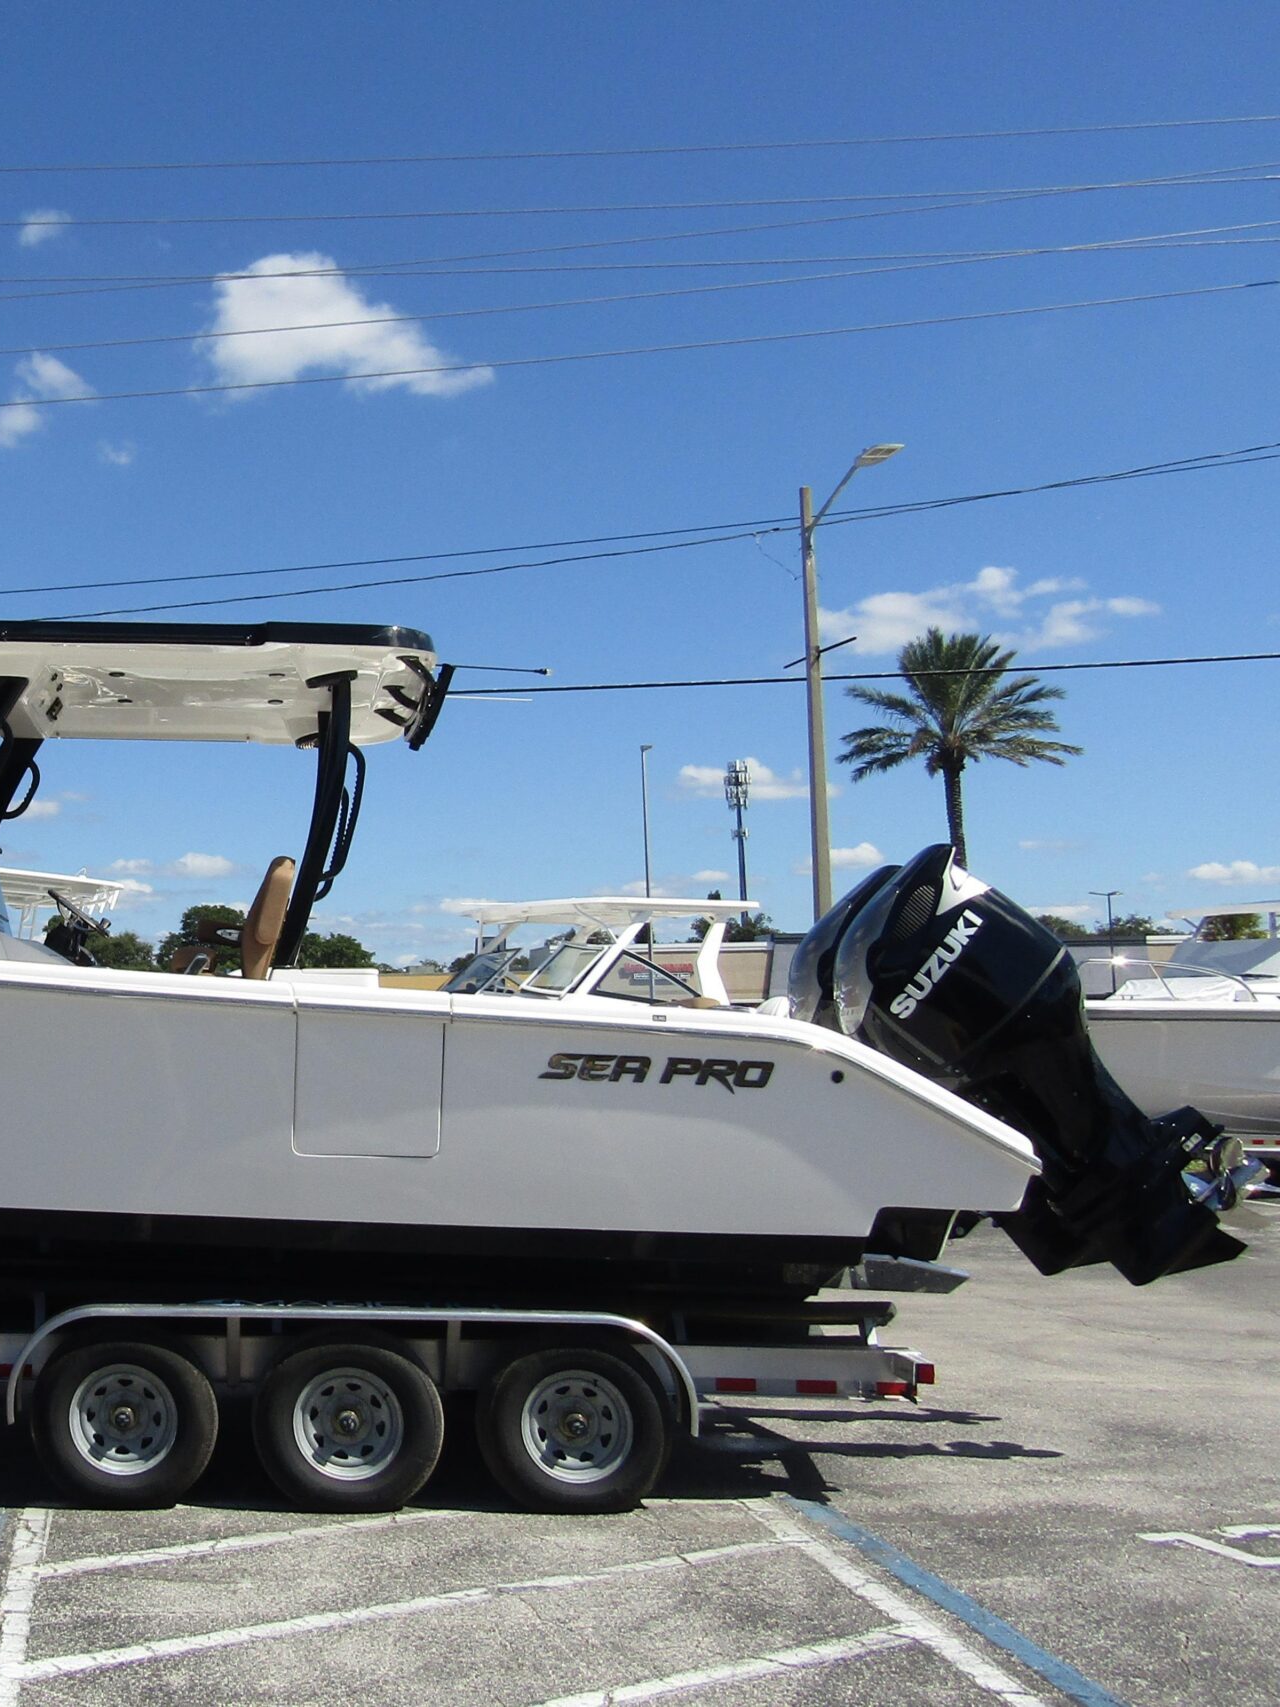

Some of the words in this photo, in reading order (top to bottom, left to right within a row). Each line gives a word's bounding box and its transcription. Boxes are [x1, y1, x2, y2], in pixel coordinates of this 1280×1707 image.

[889, 908, 984, 1020] SUZUKI
[537, 1052, 652, 1084] SEA
[659, 1056, 775, 1095] PRO
